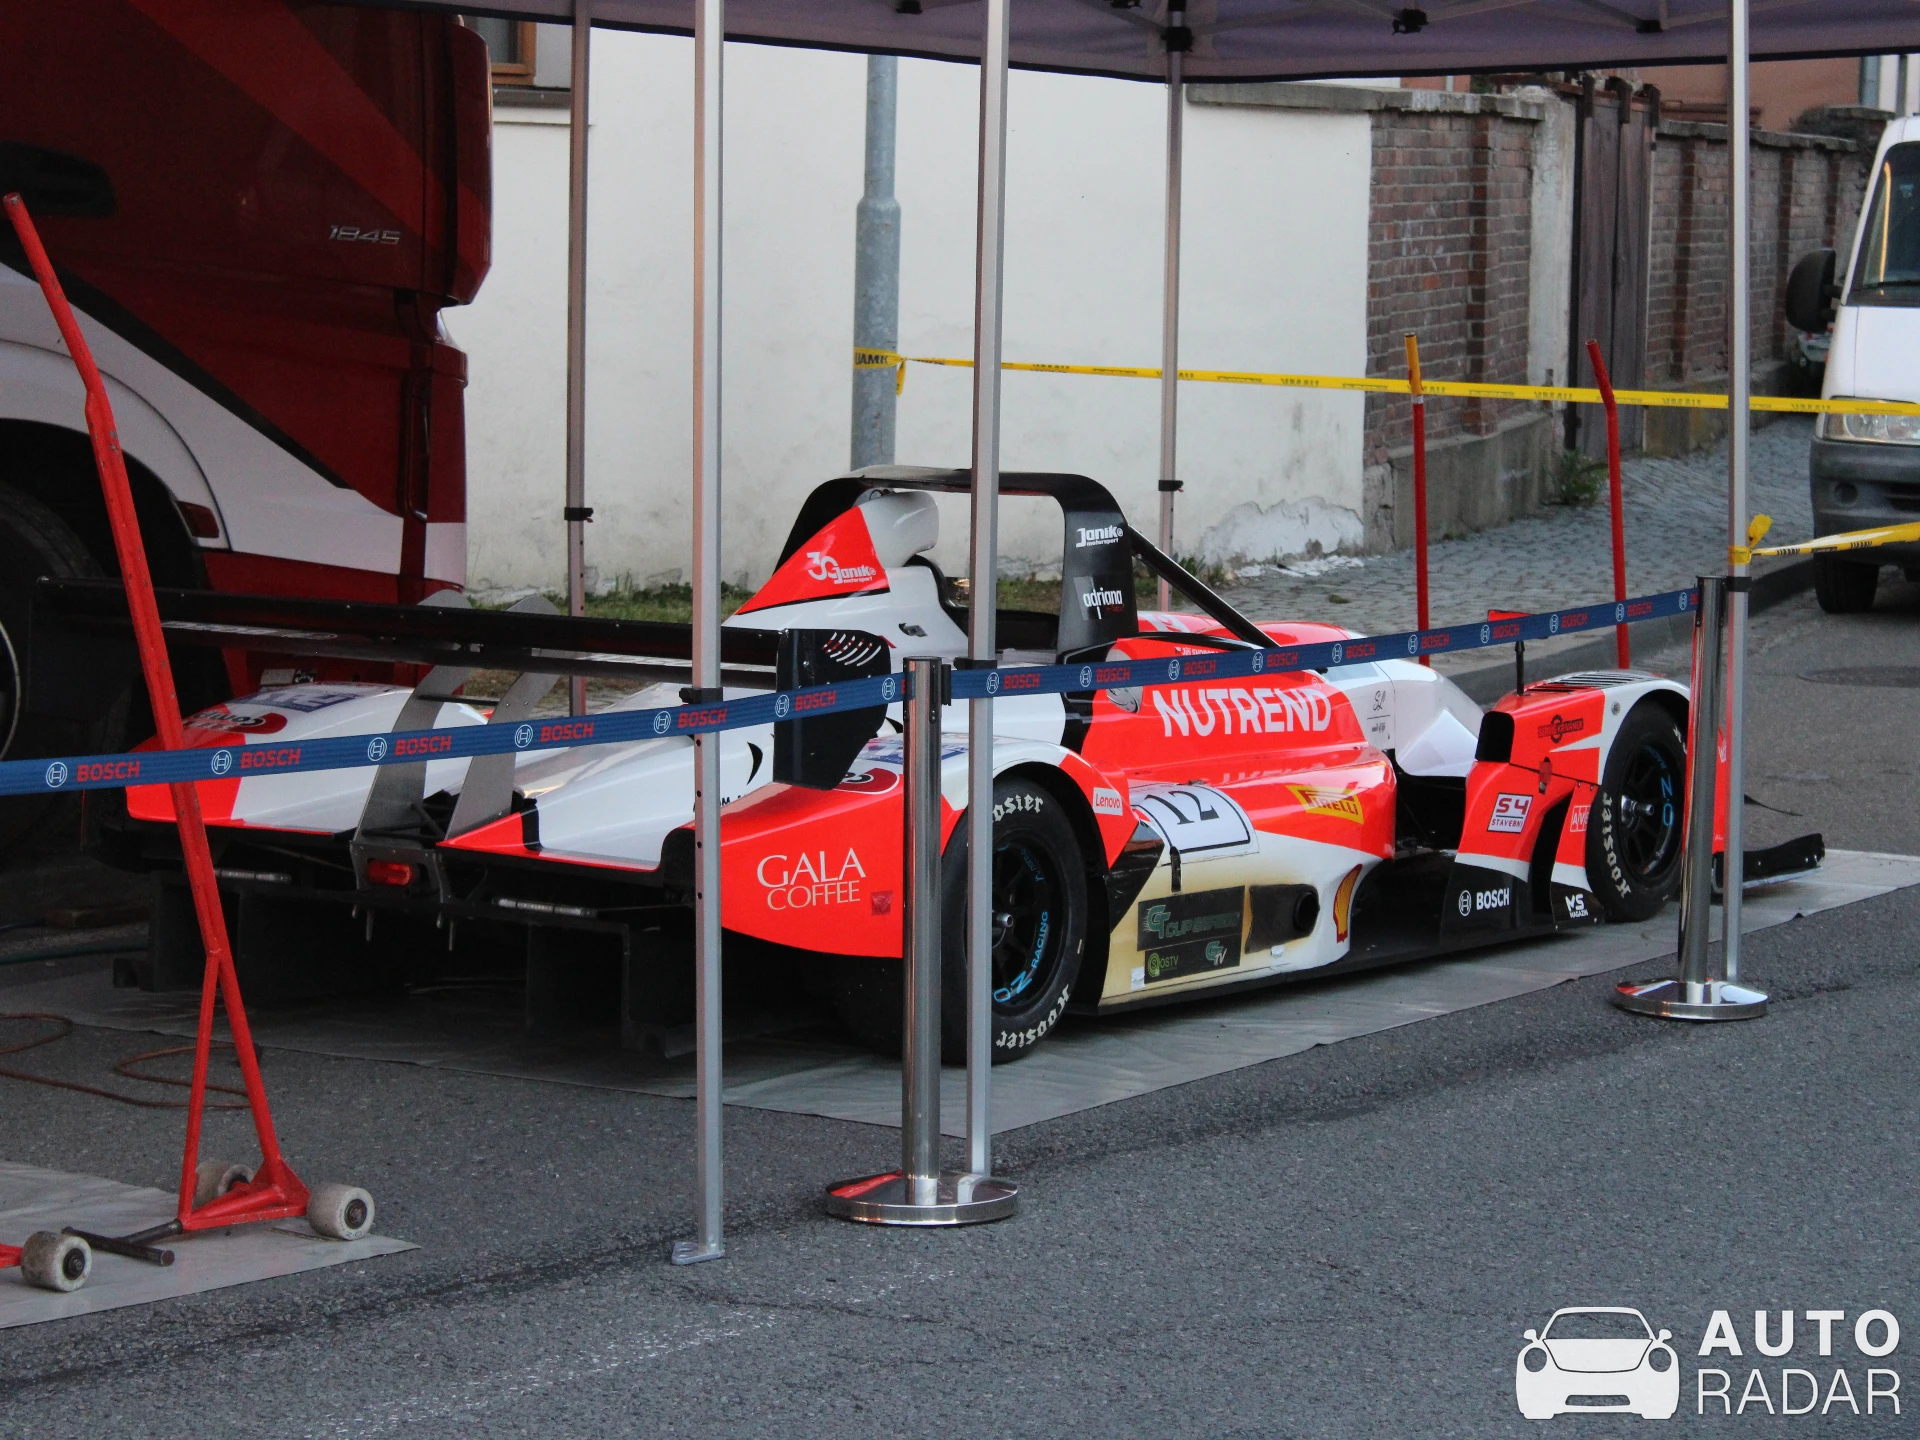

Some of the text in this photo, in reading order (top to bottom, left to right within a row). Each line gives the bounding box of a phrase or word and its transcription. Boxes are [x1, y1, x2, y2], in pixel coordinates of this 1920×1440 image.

[330, 225, 401, 245] 1845
[1083, 587, 1123, 608] adriana
[1627, 602, 1653, 617] BOSCH
[1561, 613, 1588, 628] BOSCH
[1421, 634, 1449, 649] BOSCH
[1493, 624, 1520, 639] BOSCH
[1267, 652, 1298, 668] BOSCH
[1346, 643, 1375, 659] BOSCH
[1096, 667, 1131, 683] BOSCH
[1183, 660, 1217, 676] BOSCH
[1004, 673, 1041, 690] BOSCH
[795, 690, 837, 711] BOSCH
[677, 708, 728, 729] BOSCH
[1152, 688, 1332, 737] NUTREND
[540, 722, 595, 742] BOSCH
[395, 735, 452, 756] BOSCH
[240, 748, 301, 769] BOSCH
[76, 761, 141, 782] BOSCH
[992, 793, 1044, 822] osier
[1095, 793, 1121, 808] Lenovo
[1144, 791, 1219, 825] 12
[1297, 790, 1359, 816] PIRELLI
[757, 847, 866, 888] GALA
[767, 880, 861, 910] COFFEE
[1476, 887, 1510, 910] BOSCH
[1031, 911, 1048, 969] RACING
[996, 984, 1070, 1050] Hoosier
